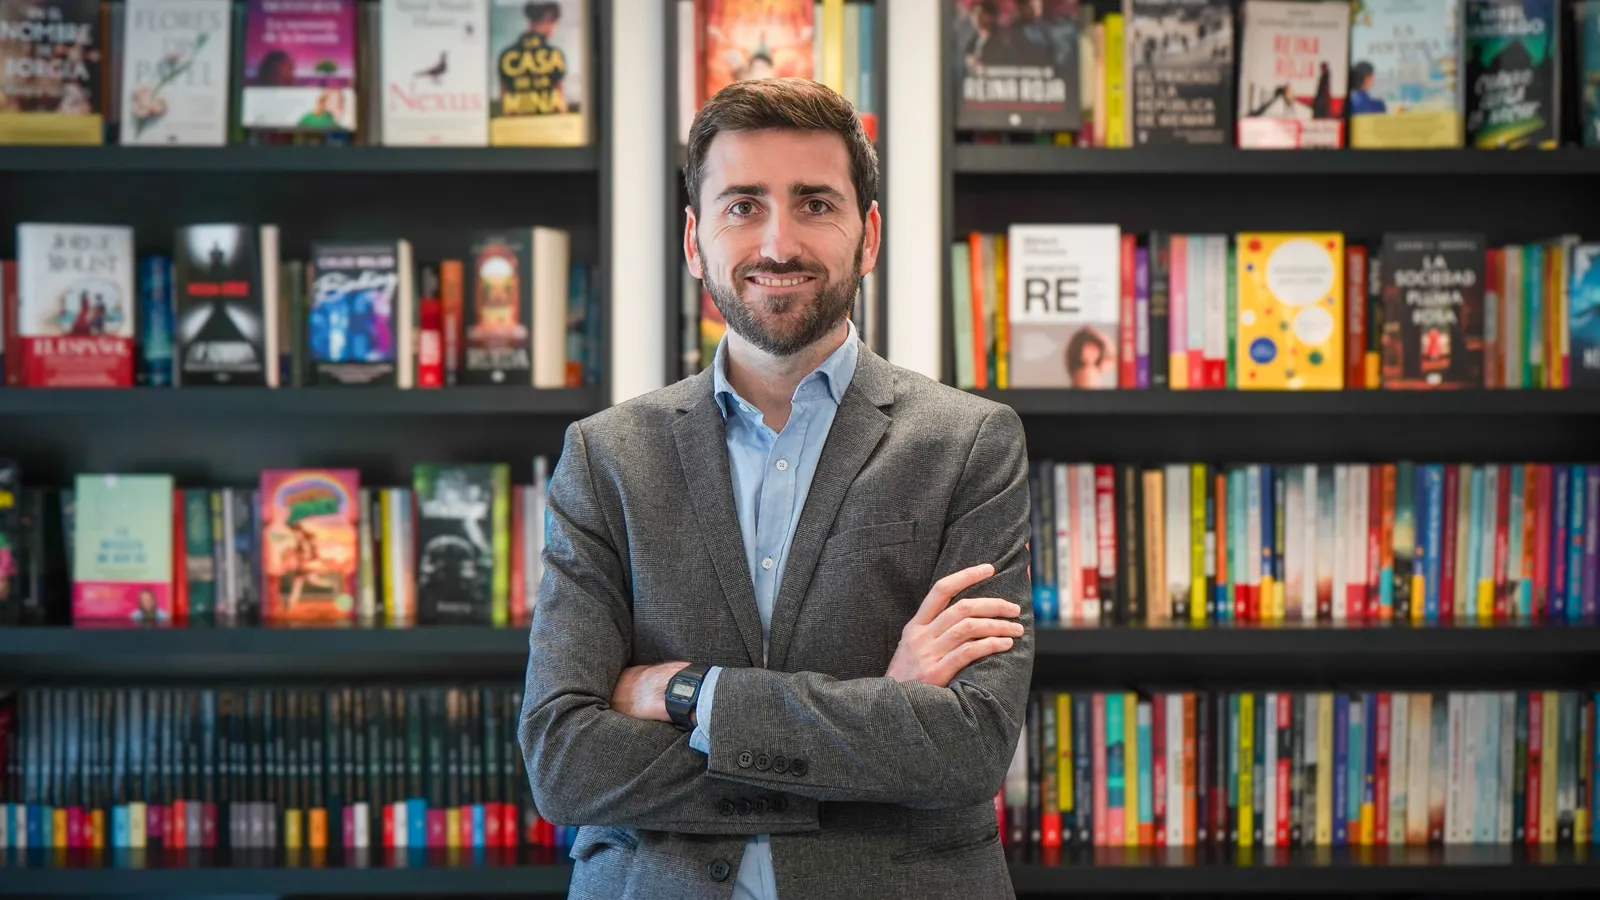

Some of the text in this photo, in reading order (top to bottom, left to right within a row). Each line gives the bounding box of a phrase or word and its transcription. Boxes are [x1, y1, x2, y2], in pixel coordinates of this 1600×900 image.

[135, 9, 222, 31] FLORES
[1273, 35, 1320, 55] REINA
[135, 60, 214, 87] PEL
[502, 49, 566, 77] CASA
[1275, 58, 1315, 80] ROJA
[388, 82, 482, 112] Nexus
[963, 78, 1066, 102] REINA ROJA
[502, 89, 568, 115] MINA
[1422, 255, 1447, 270] LA
[1394, 269, 1476, 287] SOCIEDAD
[1023, 277, 1080, 314] RE
[1405, 290, 1463, 307] PLUMA
[1412, 308, 1458, 326] ROSA
